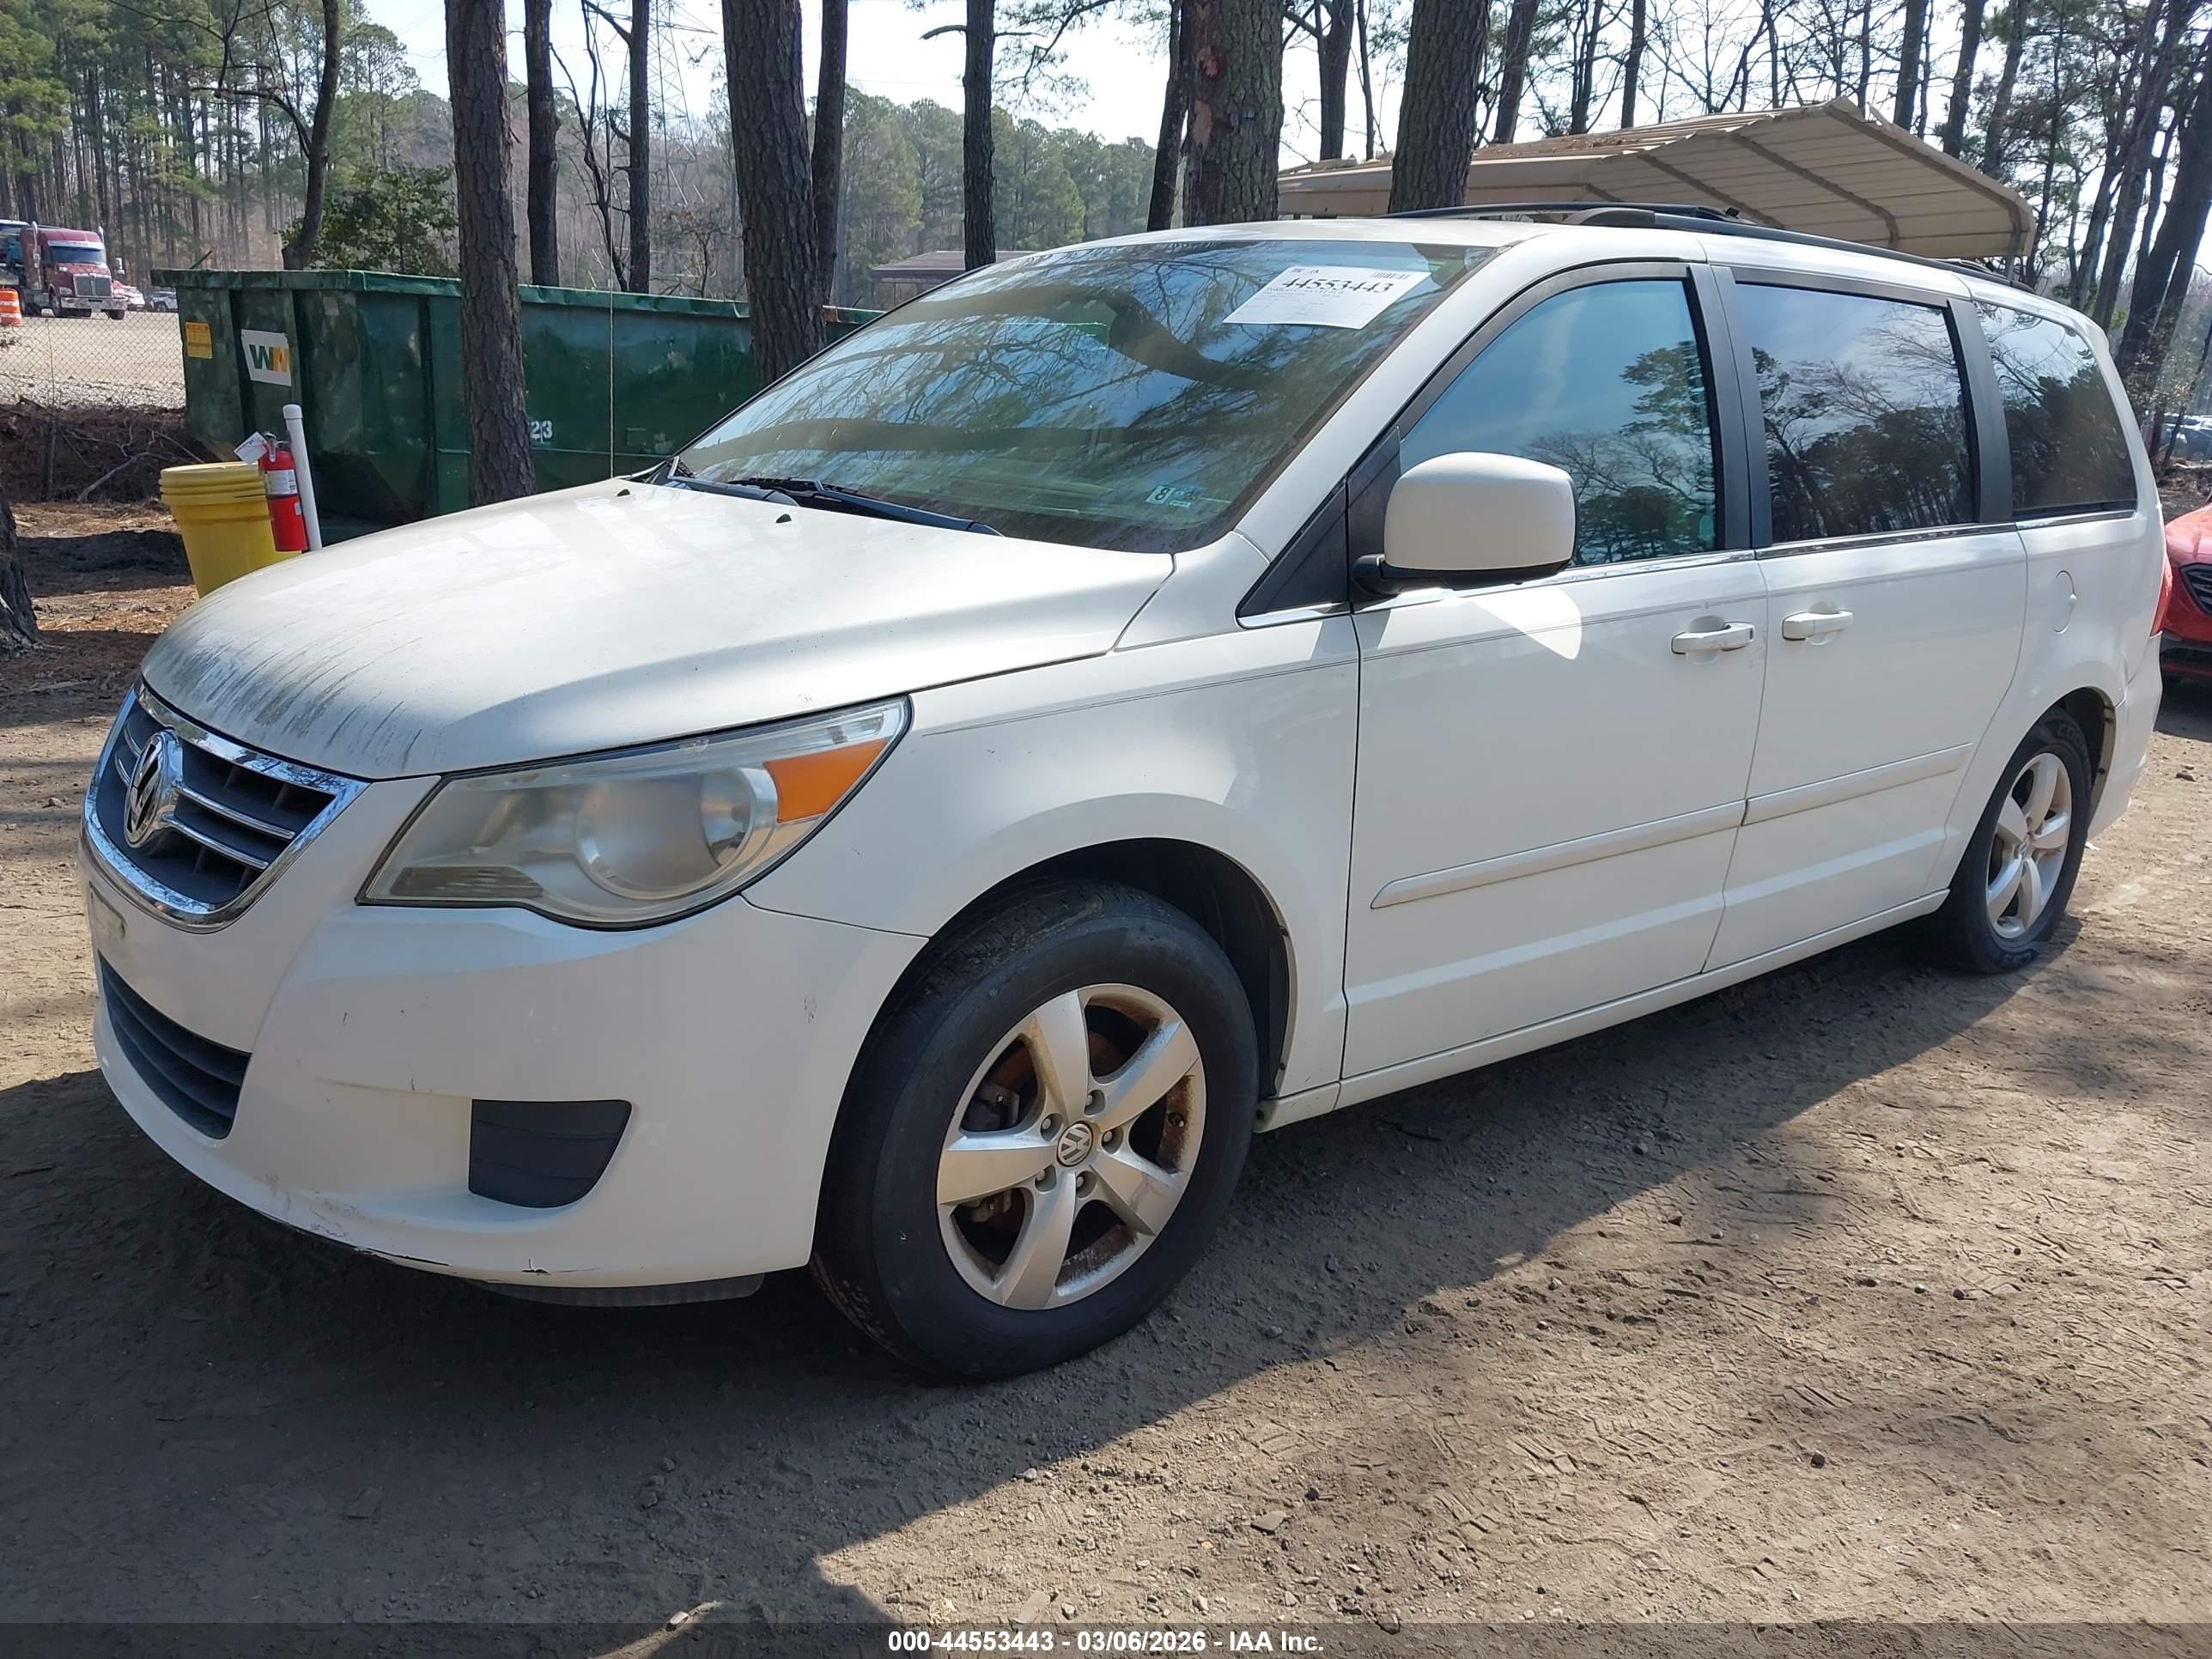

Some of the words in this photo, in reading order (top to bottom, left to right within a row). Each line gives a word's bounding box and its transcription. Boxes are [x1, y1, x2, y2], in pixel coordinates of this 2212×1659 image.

[1282, 276, 1394, 293] 44553443
[1154, 487, 1170, 501] 8
[1058, 1122, 1092, 1166] VW
